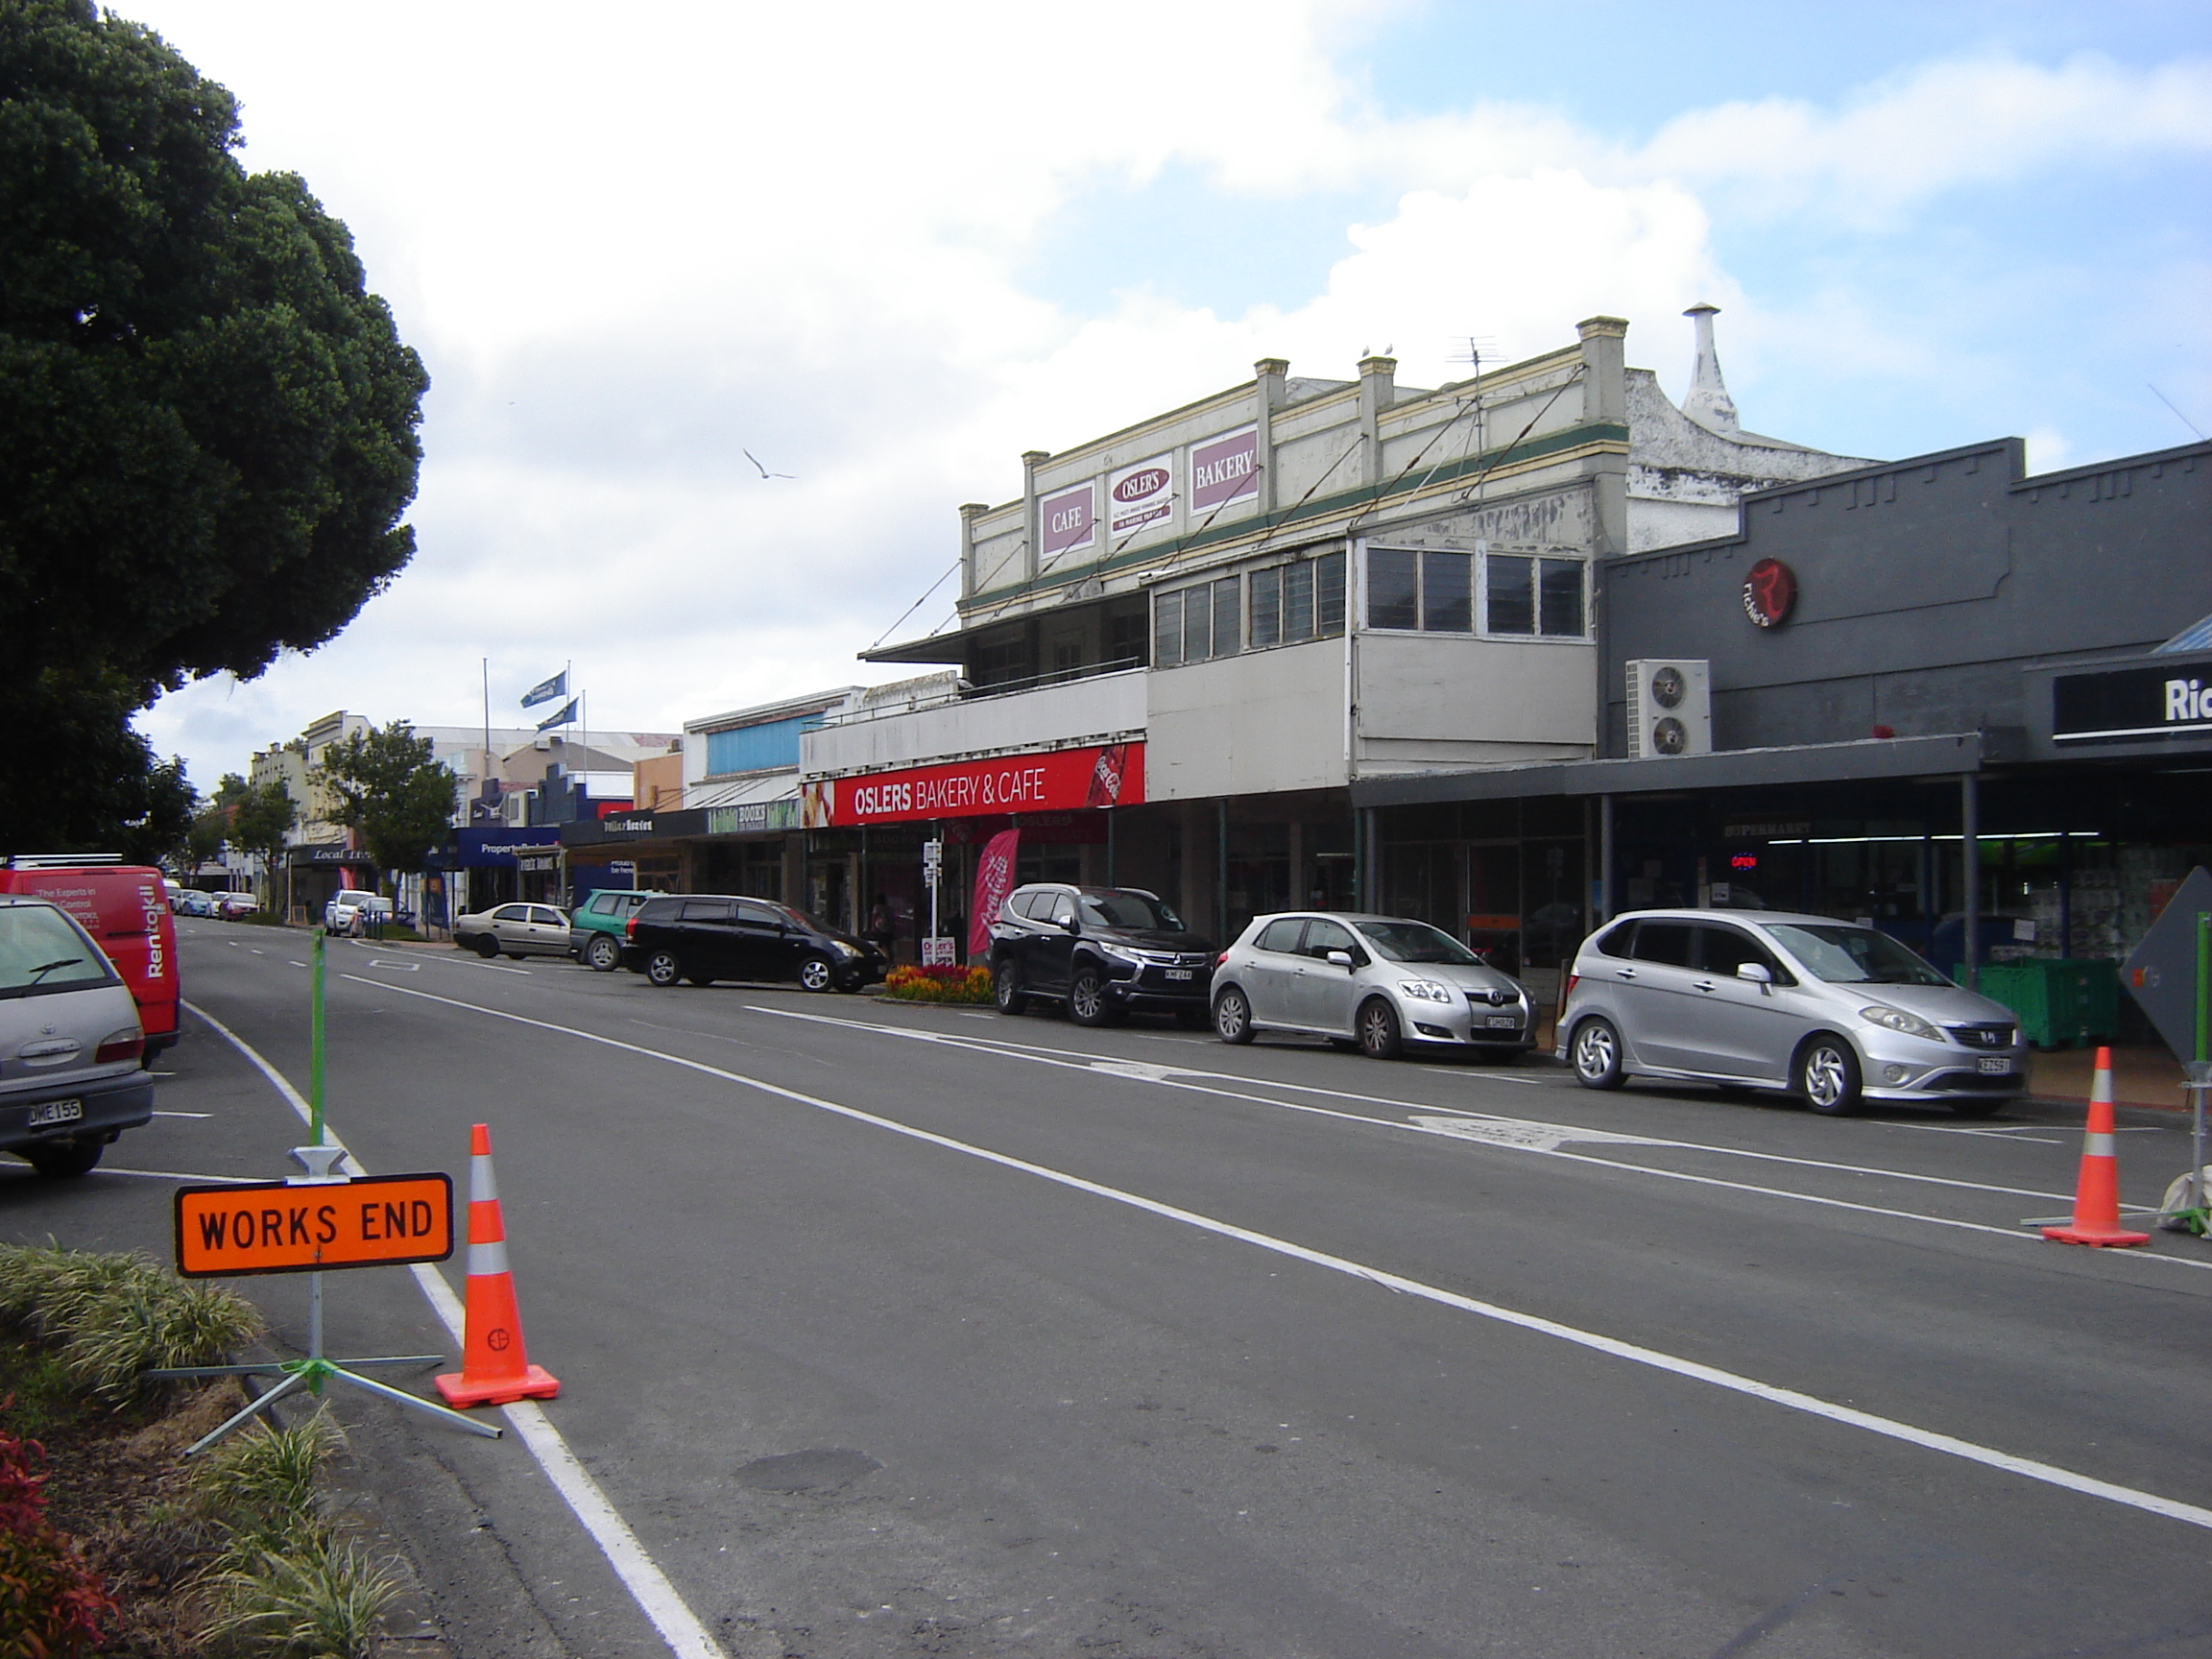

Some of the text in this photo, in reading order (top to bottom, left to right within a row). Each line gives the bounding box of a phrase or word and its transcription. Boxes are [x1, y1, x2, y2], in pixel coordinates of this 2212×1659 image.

[1196, 449, 1254, 490] BAKERY
[1122, 470, 1160, 499] OSLER'S
[1052, 506, 1082, 534] CAFE
[1743, 582, 1769, 627] richie's
[854, 768, 1045, 815] OSLERS BAKERY & CAFE
[738, 804, 765, 823] BOOKS
[314, 849, 344, 859] Local
[1731, 857, 1756, 867] OPEN
[37, 889, 55, 898] The
[58, 888, 86, 900] Experts
[60, 900, 91, 908] Control
[138, 885, 163, 978] Rentokil
[199, 1200, 432, 1250] WORKS END
